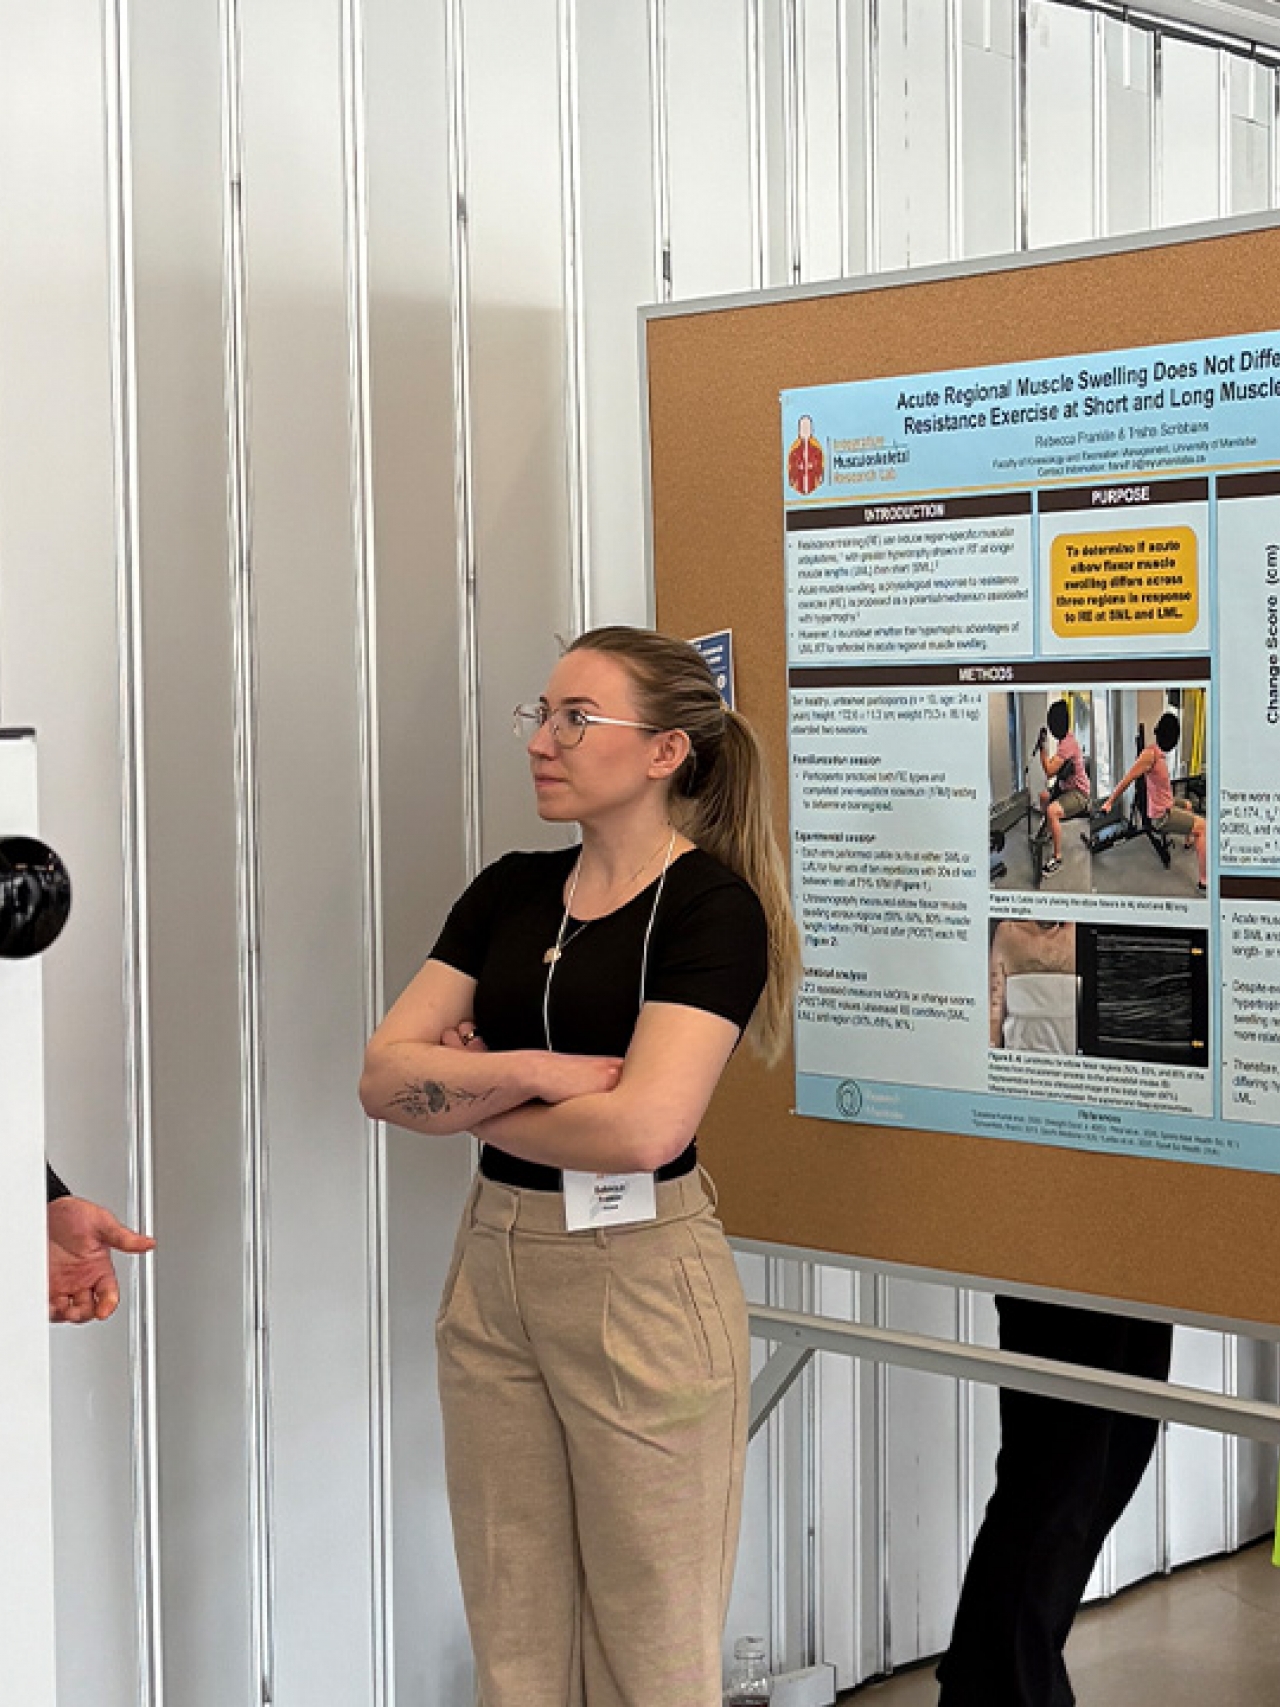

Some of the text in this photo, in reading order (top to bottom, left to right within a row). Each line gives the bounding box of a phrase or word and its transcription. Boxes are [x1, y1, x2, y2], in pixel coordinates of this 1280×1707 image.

[897, 391, 940, 410] Acute
[945, 379, 1011, 407] Regional
[1016, 373, 1073, 397] Muscle
[1078, 366, 1147, 392] Swelling
[1154, 360, 1198, 382] Does
[1204, 354, 1235, 377] Not
[904, 412, 986, 435] Resistance
[990, 402, 1058, 427] Exercise
[1063, 401, 1079, 418] at
[1084, 394, 1129, 416] Short
[1133, 389, 1164, 411] and
[1170, 382, 1214, 409] Long
[864, 504, 945, 522] INTRODUCTION
[1091, 485, 1150, 505] PURPOSE
[1265, 545, 1280, 586] (cm)
[1266, 596, 1279, 648] Score
[958, 665, 1015, 682] METHODS
